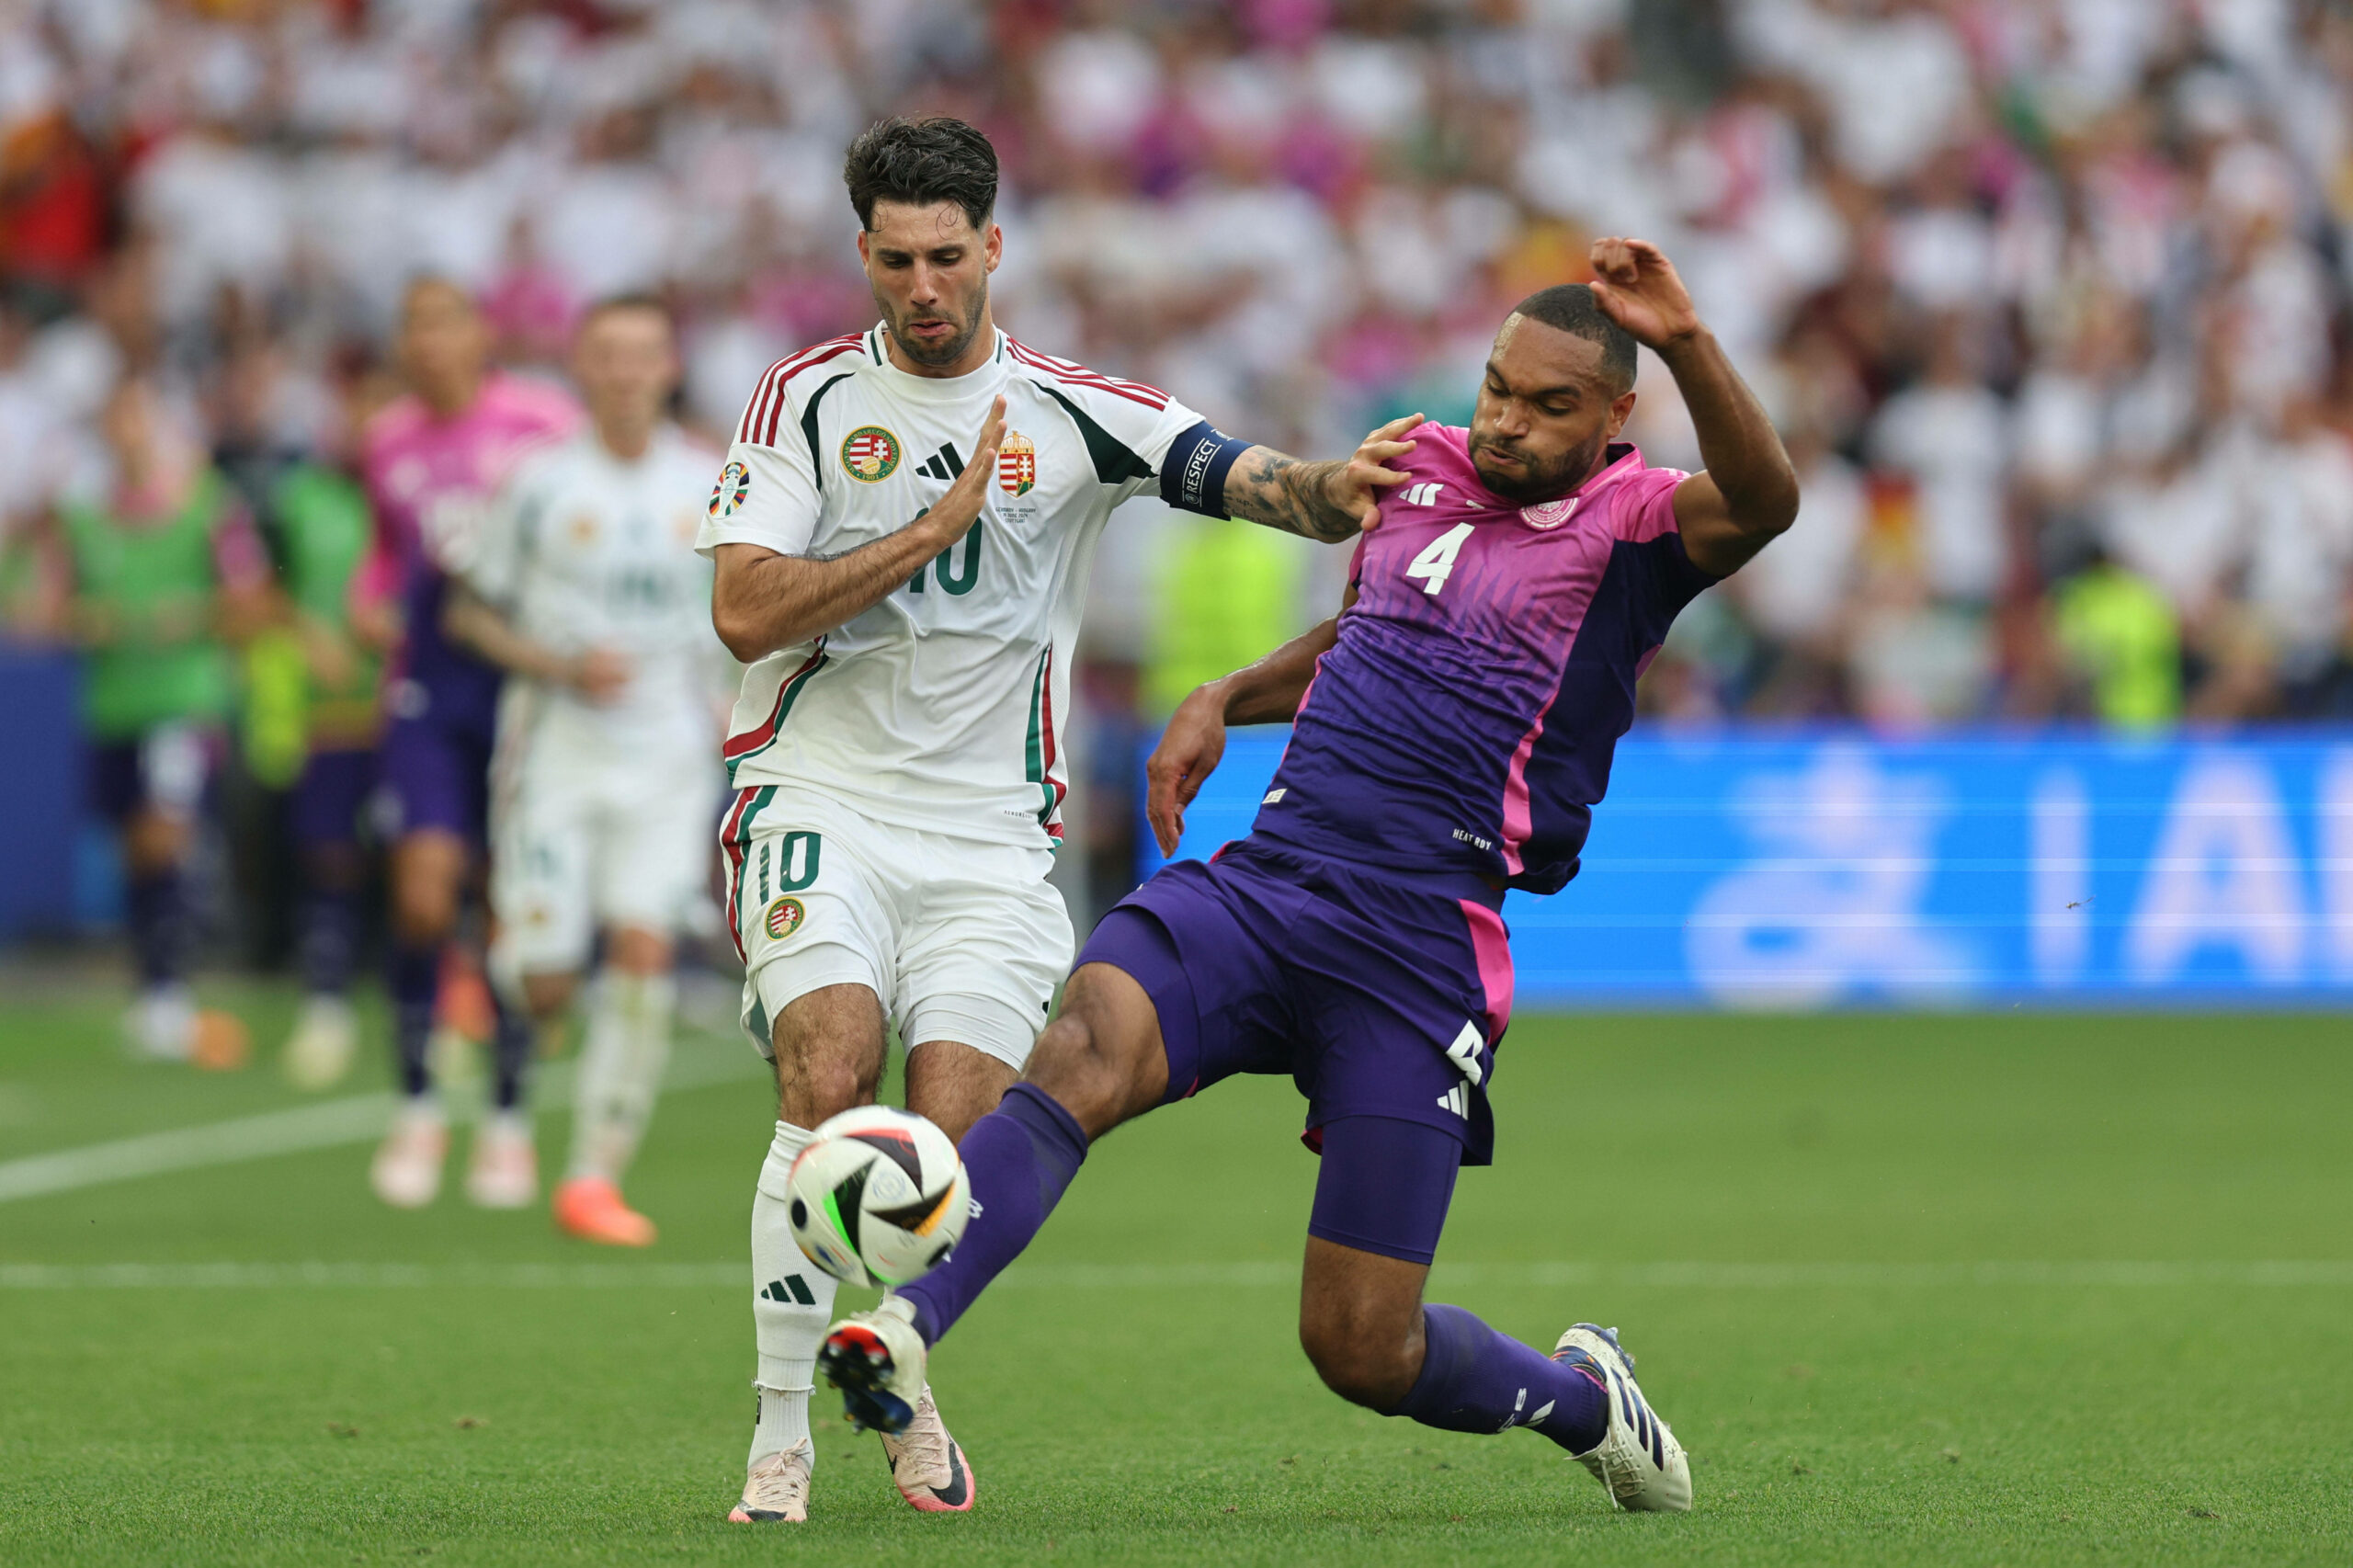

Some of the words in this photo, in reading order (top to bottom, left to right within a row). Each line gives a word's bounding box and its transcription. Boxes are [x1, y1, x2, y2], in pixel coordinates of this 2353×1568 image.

[1187, 439, 1217, 494] RESPECT
[1405, 521, 1476, 596] 4
[758, 831, 822, 906] 10
[1452, 828, 1474, 843] HEAT
[1473, 836, 1493, 851] RDY
